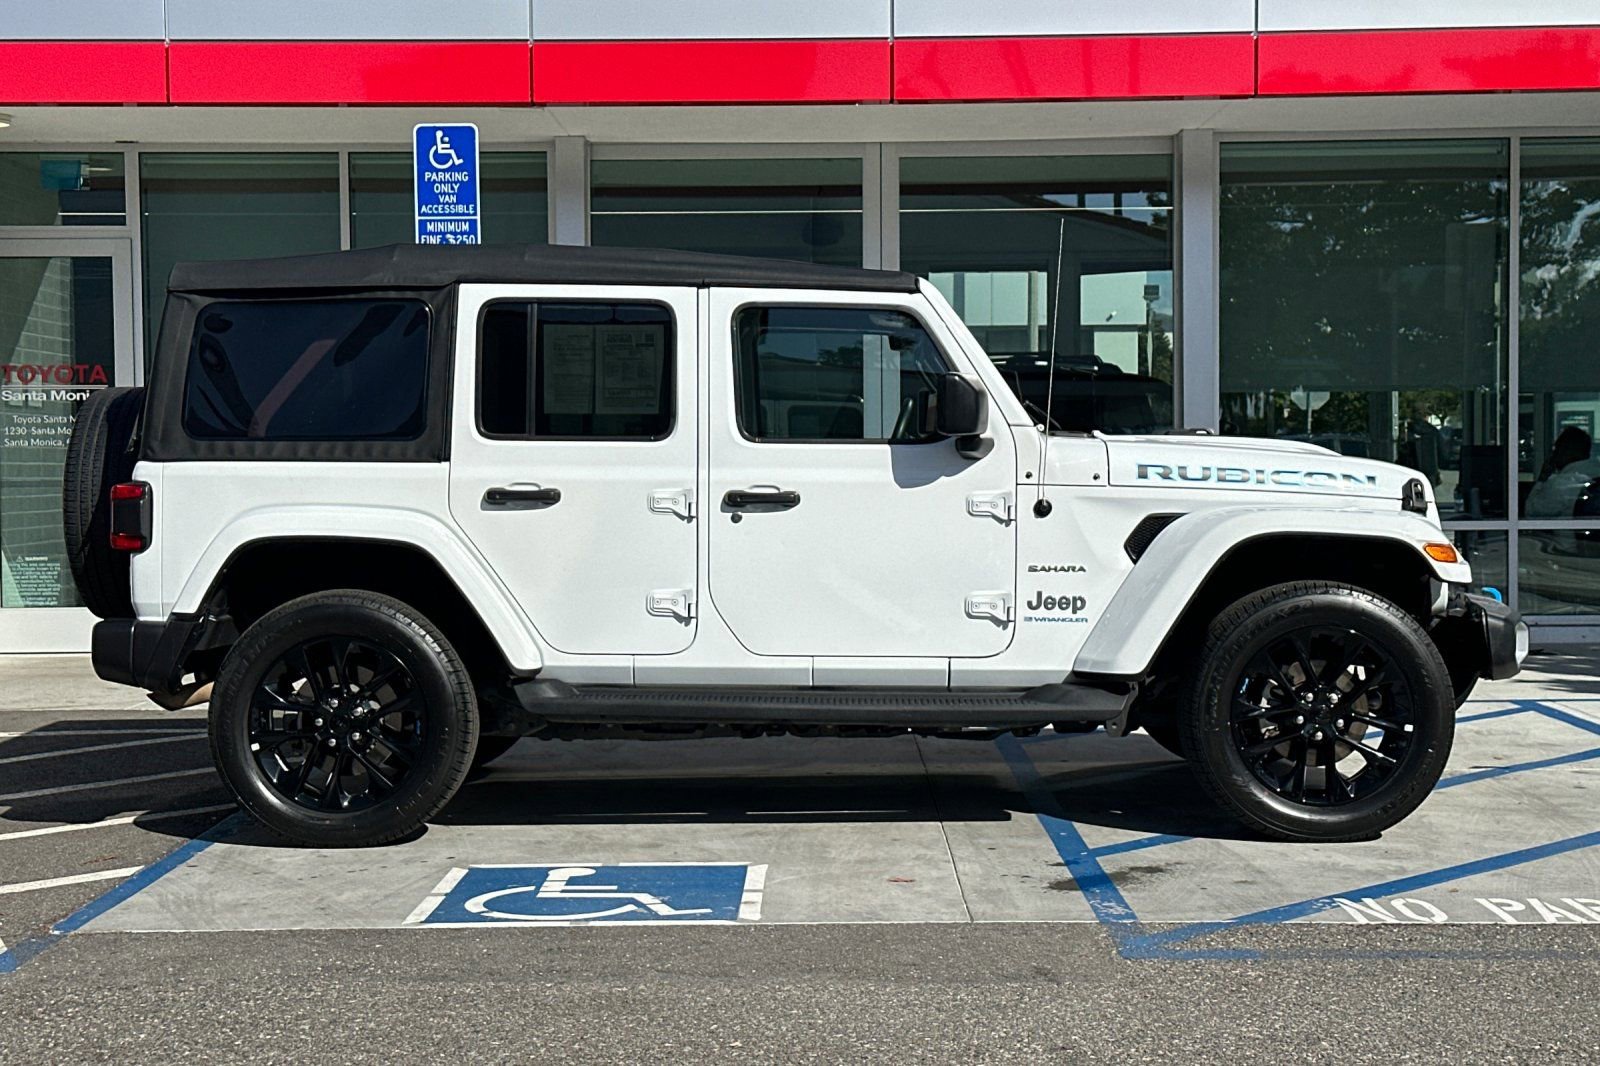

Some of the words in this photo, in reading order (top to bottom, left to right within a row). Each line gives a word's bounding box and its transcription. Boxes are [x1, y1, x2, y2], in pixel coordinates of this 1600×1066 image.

[424, 172, 469, 182] PARKING
[433, 183, 460, 193] ONLY
[438, 194, 457, 203] VAN
[420, 204, 475, 214] ACCESSIBLE
[426, 221, 470, 233] MINIMUM
[1, 364, 108, 384] TOYOTA
[1, 389, 47, 401] Santa
[13, 415, 41, 425] Toyota
[43, 415, 68, 424] Santa
[4, 427, 27, 435] 1230
[31, 426, 56, 435] Santa
[4, 438, 28, 447] Santa
[1137, 464, 1377, 487] RUBICON
[1027, 565, 1087, 573] SAHARA
[1027, 590, 1087, 614] Jeep
[1334, 897, 1449, 922] NO
